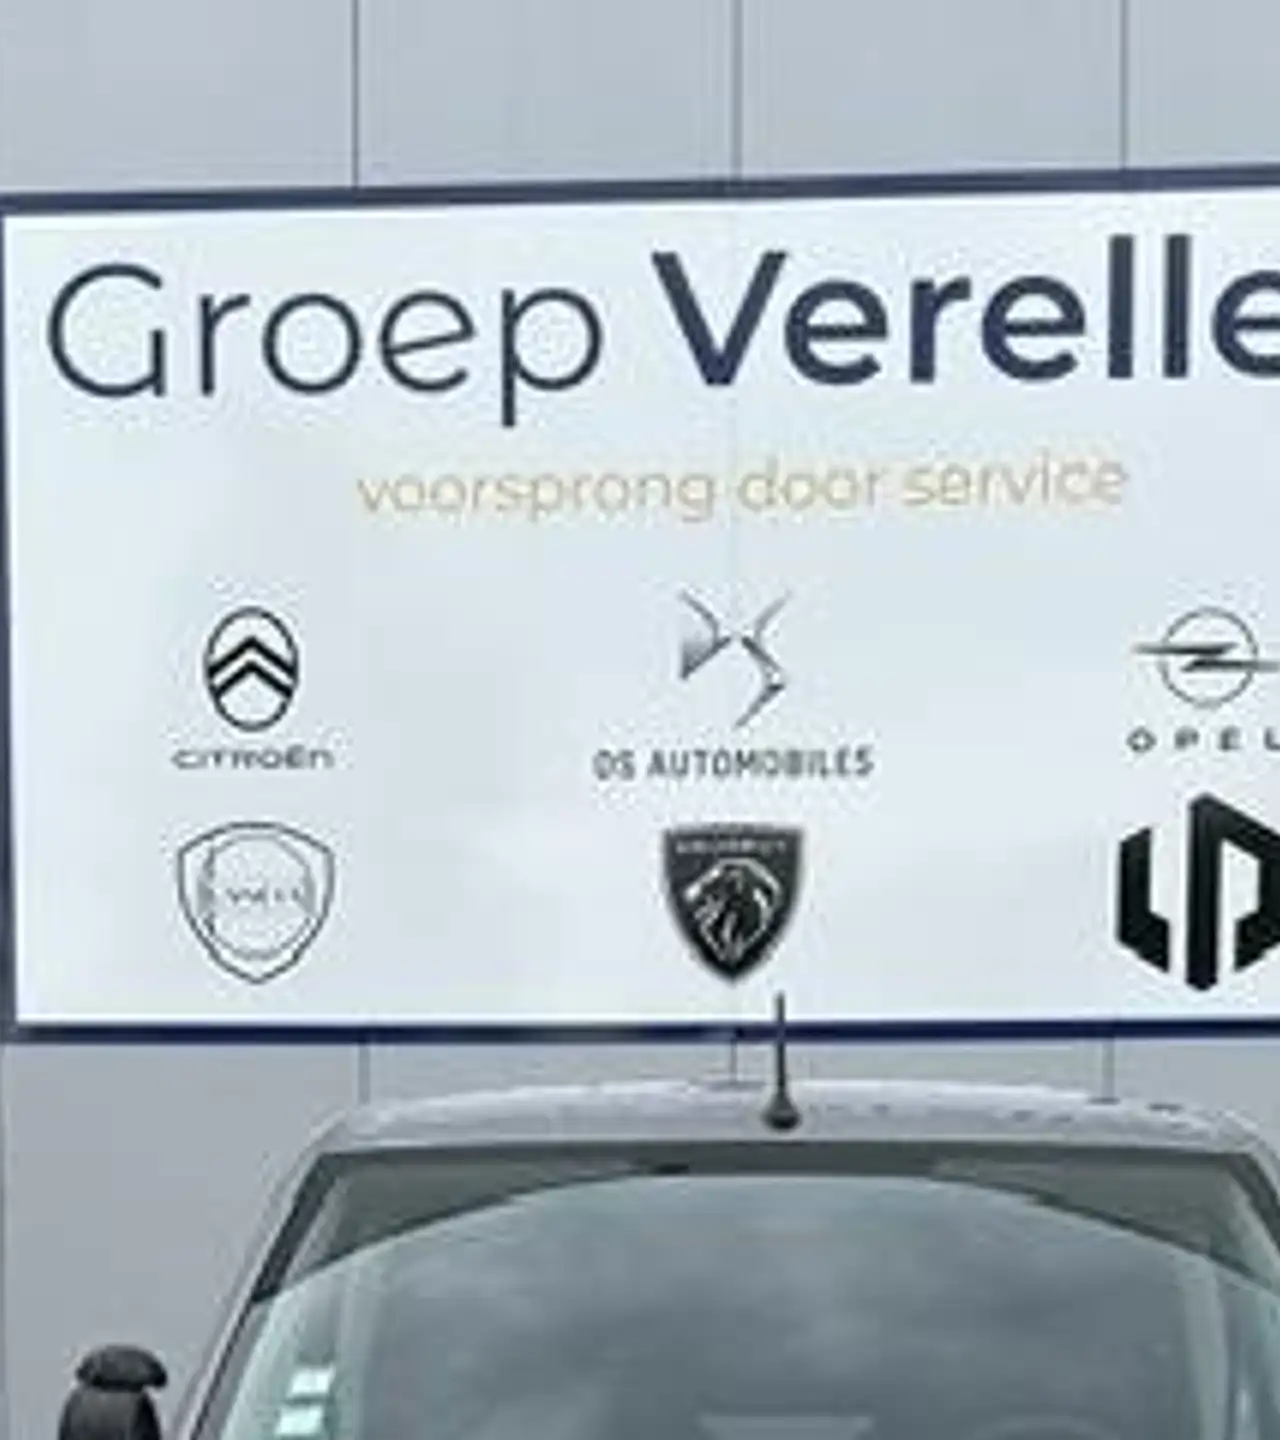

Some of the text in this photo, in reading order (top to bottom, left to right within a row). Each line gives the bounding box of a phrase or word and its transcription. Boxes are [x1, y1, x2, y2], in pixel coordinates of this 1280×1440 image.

[44, 259, 606, 431] Groep
[355, 455, 1132, 524] voorsprong door service
[591, 744, 877, 783] DS AUTOMOBILES
